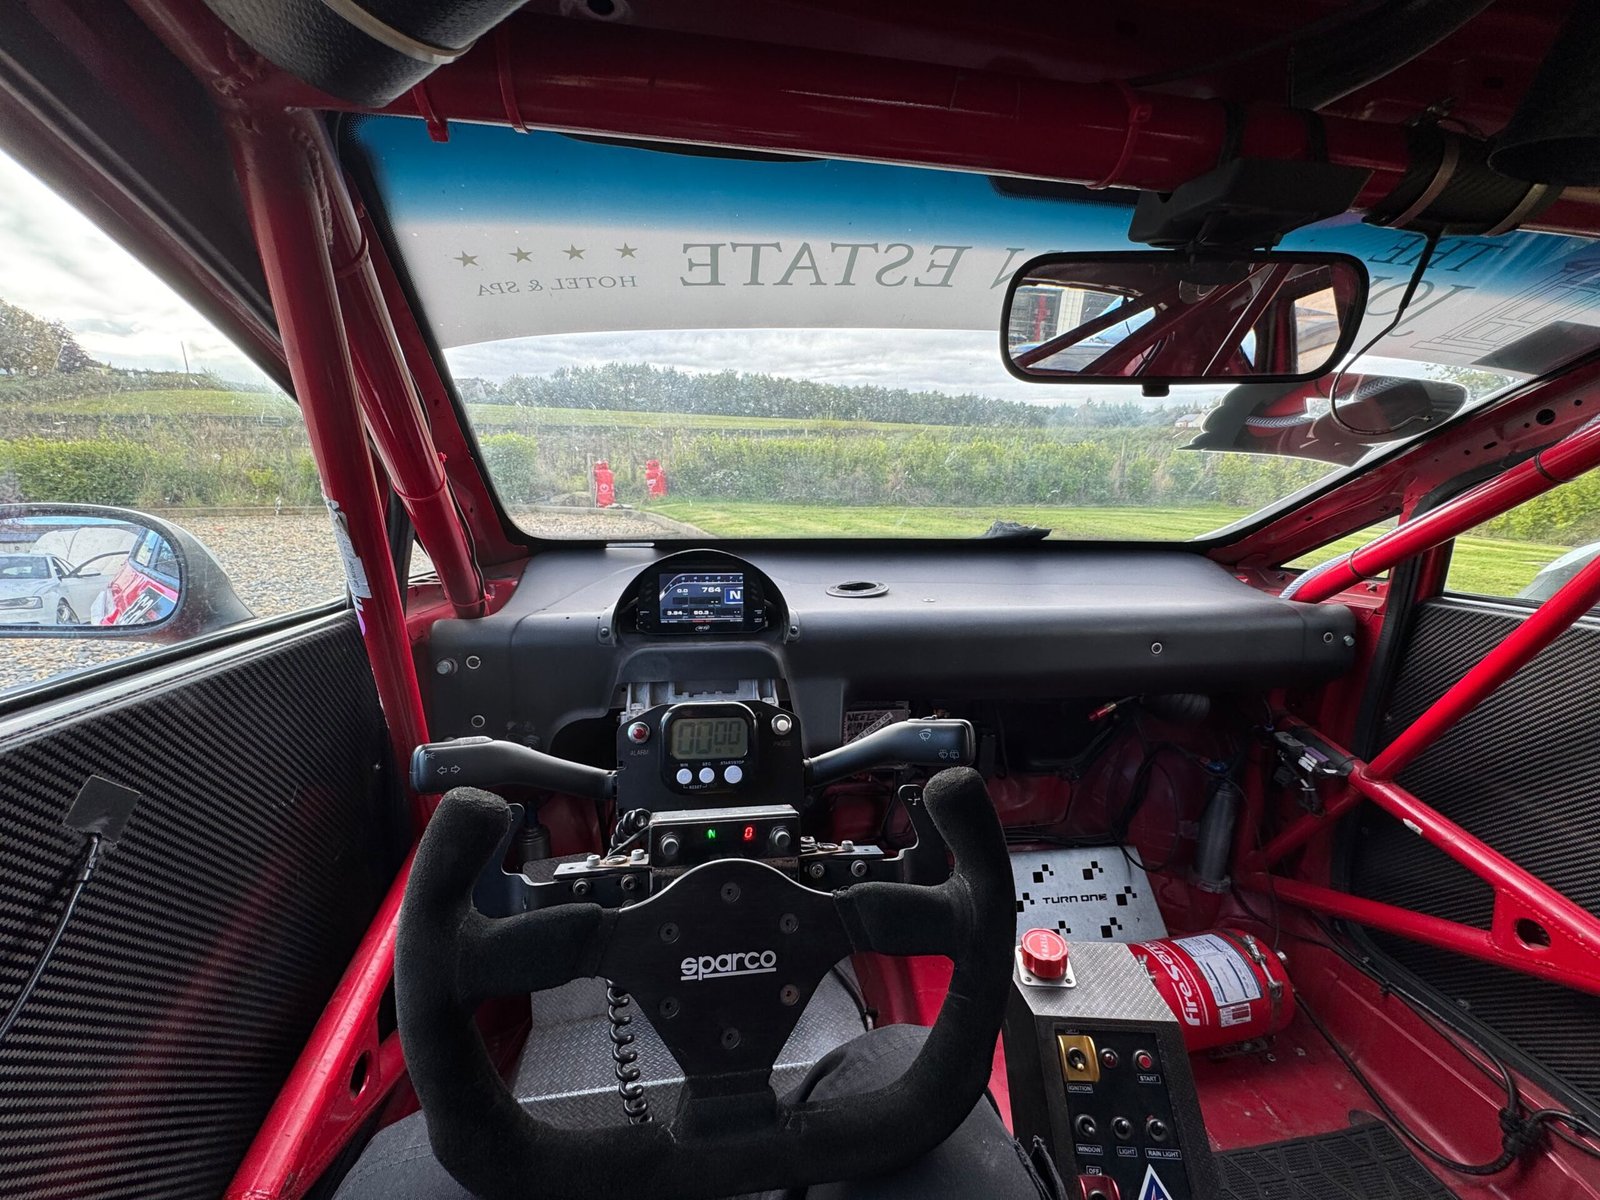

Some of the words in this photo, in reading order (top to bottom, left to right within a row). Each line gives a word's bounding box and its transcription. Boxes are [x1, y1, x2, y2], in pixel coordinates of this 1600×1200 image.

[729, 590, 741, 599] N
[707, 829, 716, 839] N
[1043, 895, 1078, 905] TURN
[1080, 893, 1108, 903] ONE
[681, 950, 777, 981] sparco
